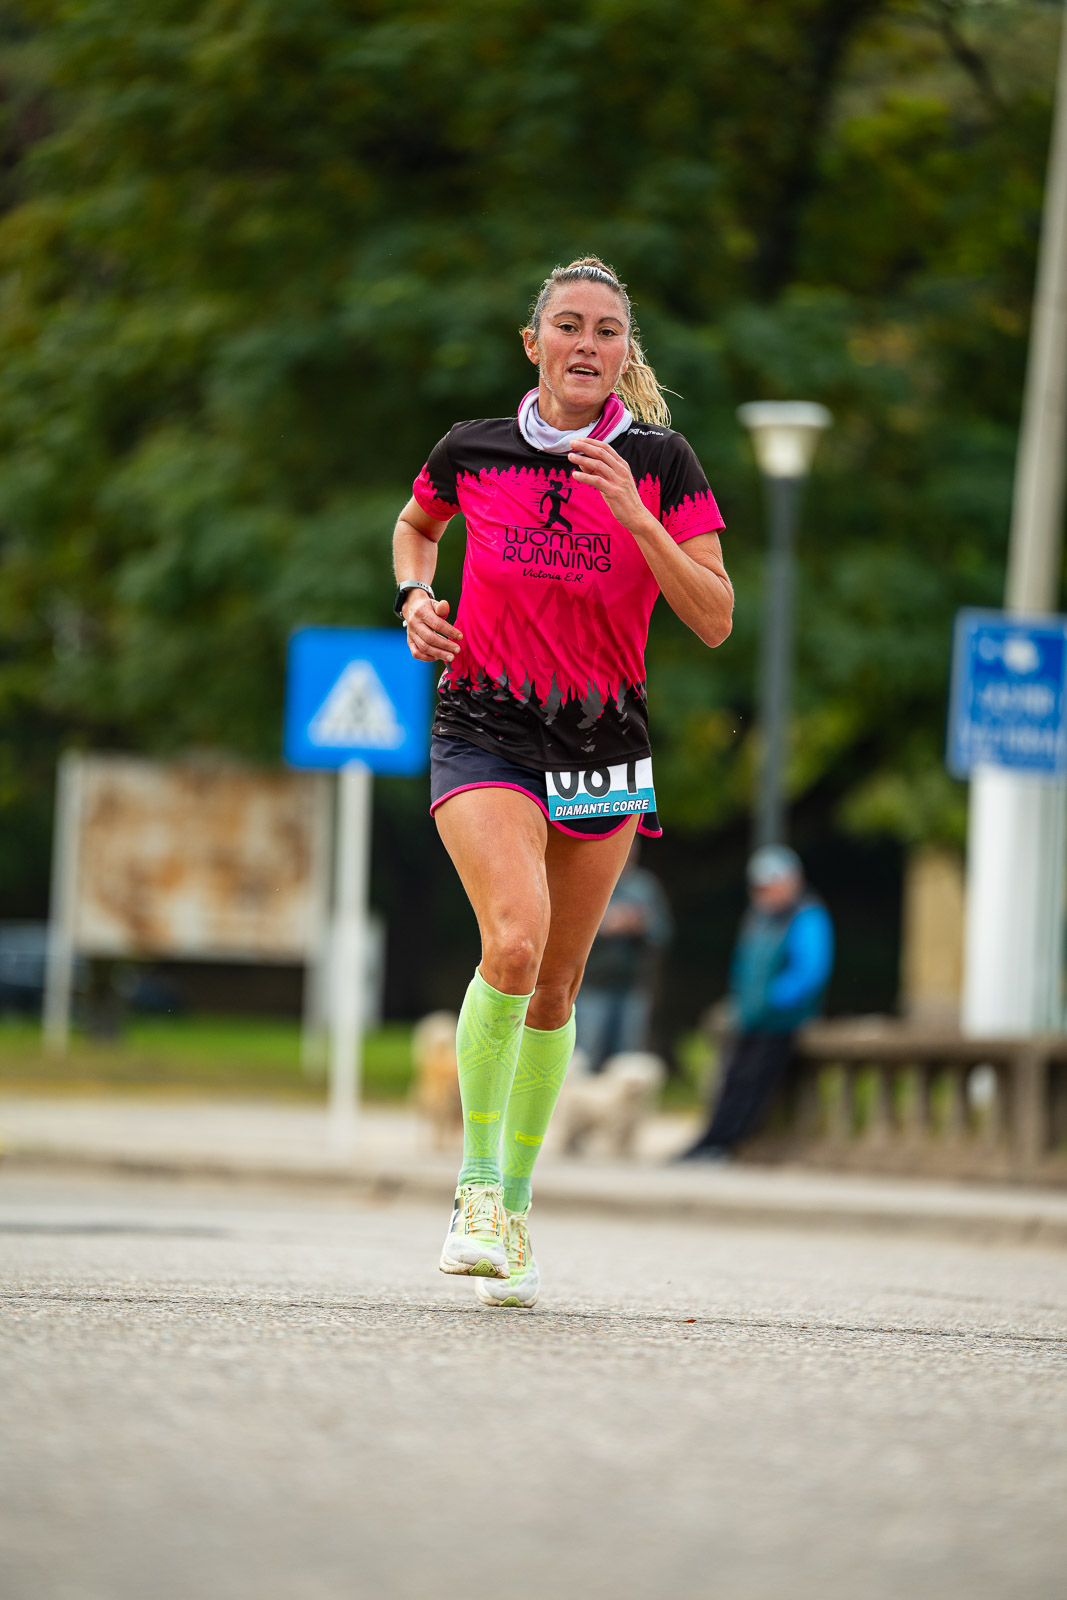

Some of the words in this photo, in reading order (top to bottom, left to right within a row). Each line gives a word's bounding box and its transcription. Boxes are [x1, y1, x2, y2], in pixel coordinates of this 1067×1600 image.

[505, 527, 611, 554] WOMAN
[502, 545, 612, 573] RUNNING
[522, 567, 562, 580] Victoria
[554, 802, 611, 818] DIAMANTE
[612, 799, 650, 813] CORRE
